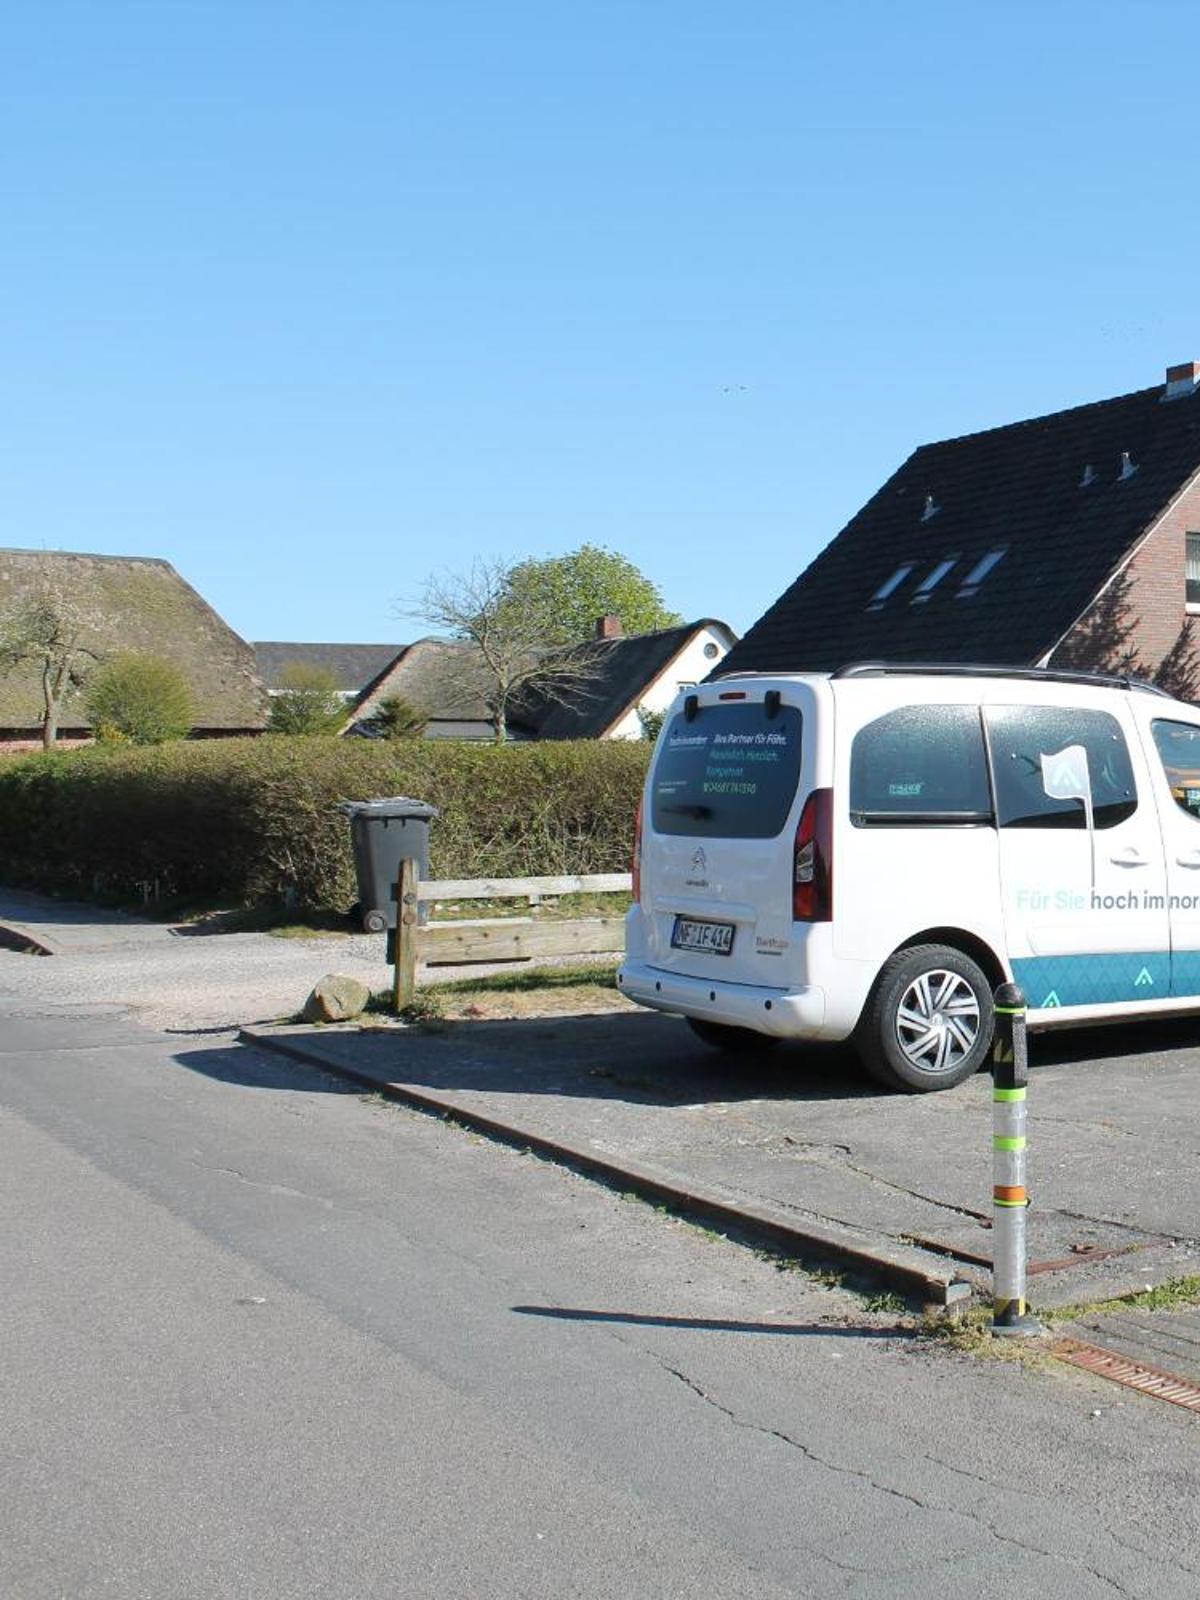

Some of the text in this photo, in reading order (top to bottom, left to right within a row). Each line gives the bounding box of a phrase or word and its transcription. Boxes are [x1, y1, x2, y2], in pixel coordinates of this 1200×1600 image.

[1016, 889, 1050, 909] Für
[1055, 889, 1085, 909] Sie
[1090, 889, 1138, 909] hoch
[1143, 889, 1164, 909] im
